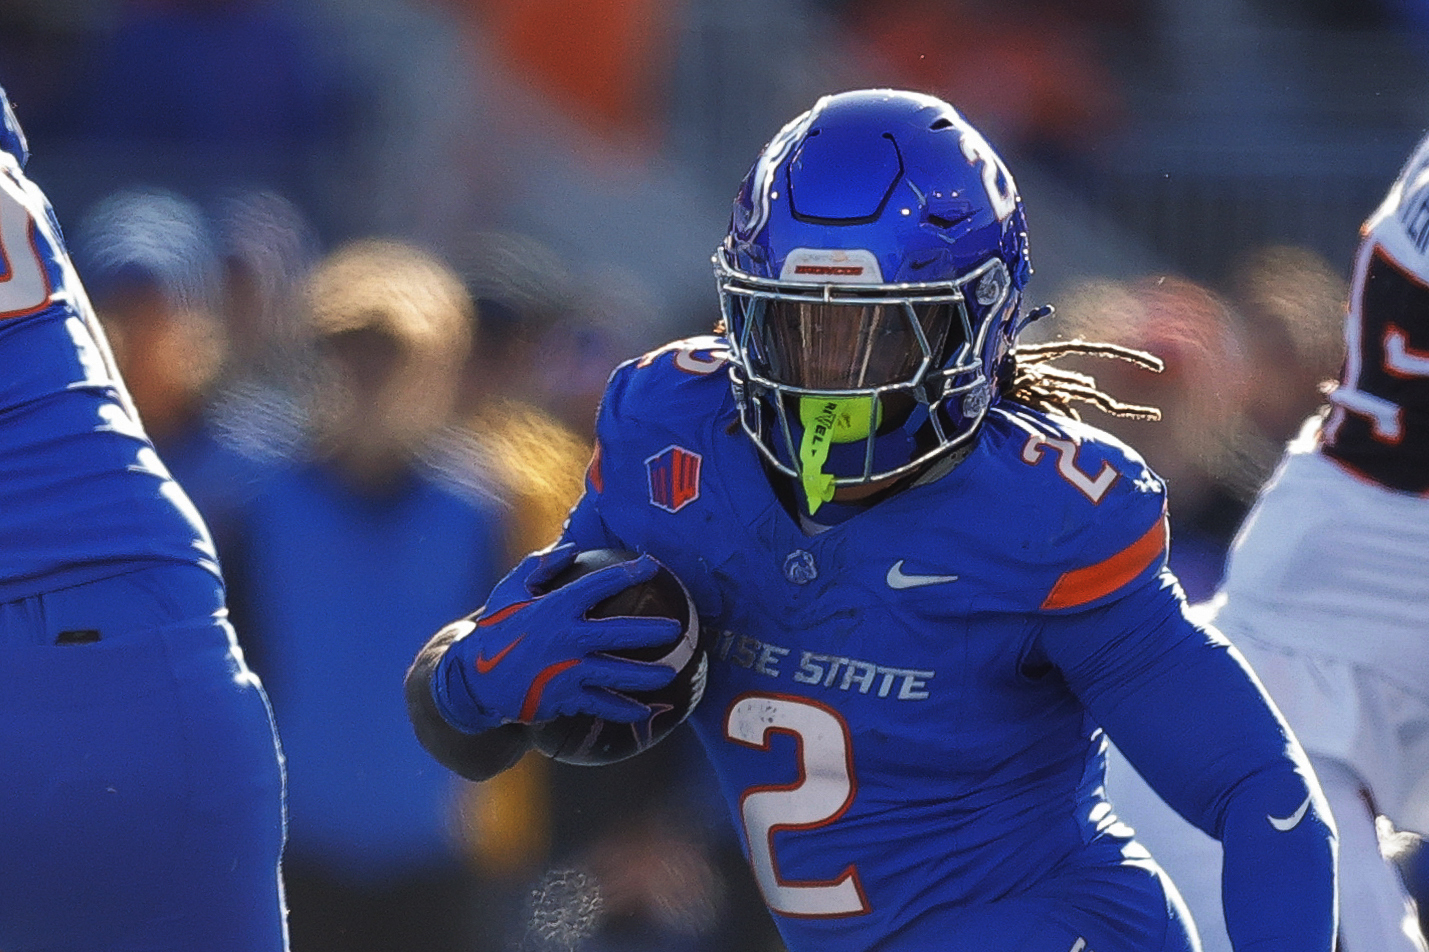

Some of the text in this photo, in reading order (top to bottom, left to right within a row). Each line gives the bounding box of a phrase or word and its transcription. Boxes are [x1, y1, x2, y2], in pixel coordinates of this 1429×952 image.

[1020, 433, 1121, 505] 2
[703, 627, 935, 700] ISE STATE
[723, 690, 872, 919] 2
